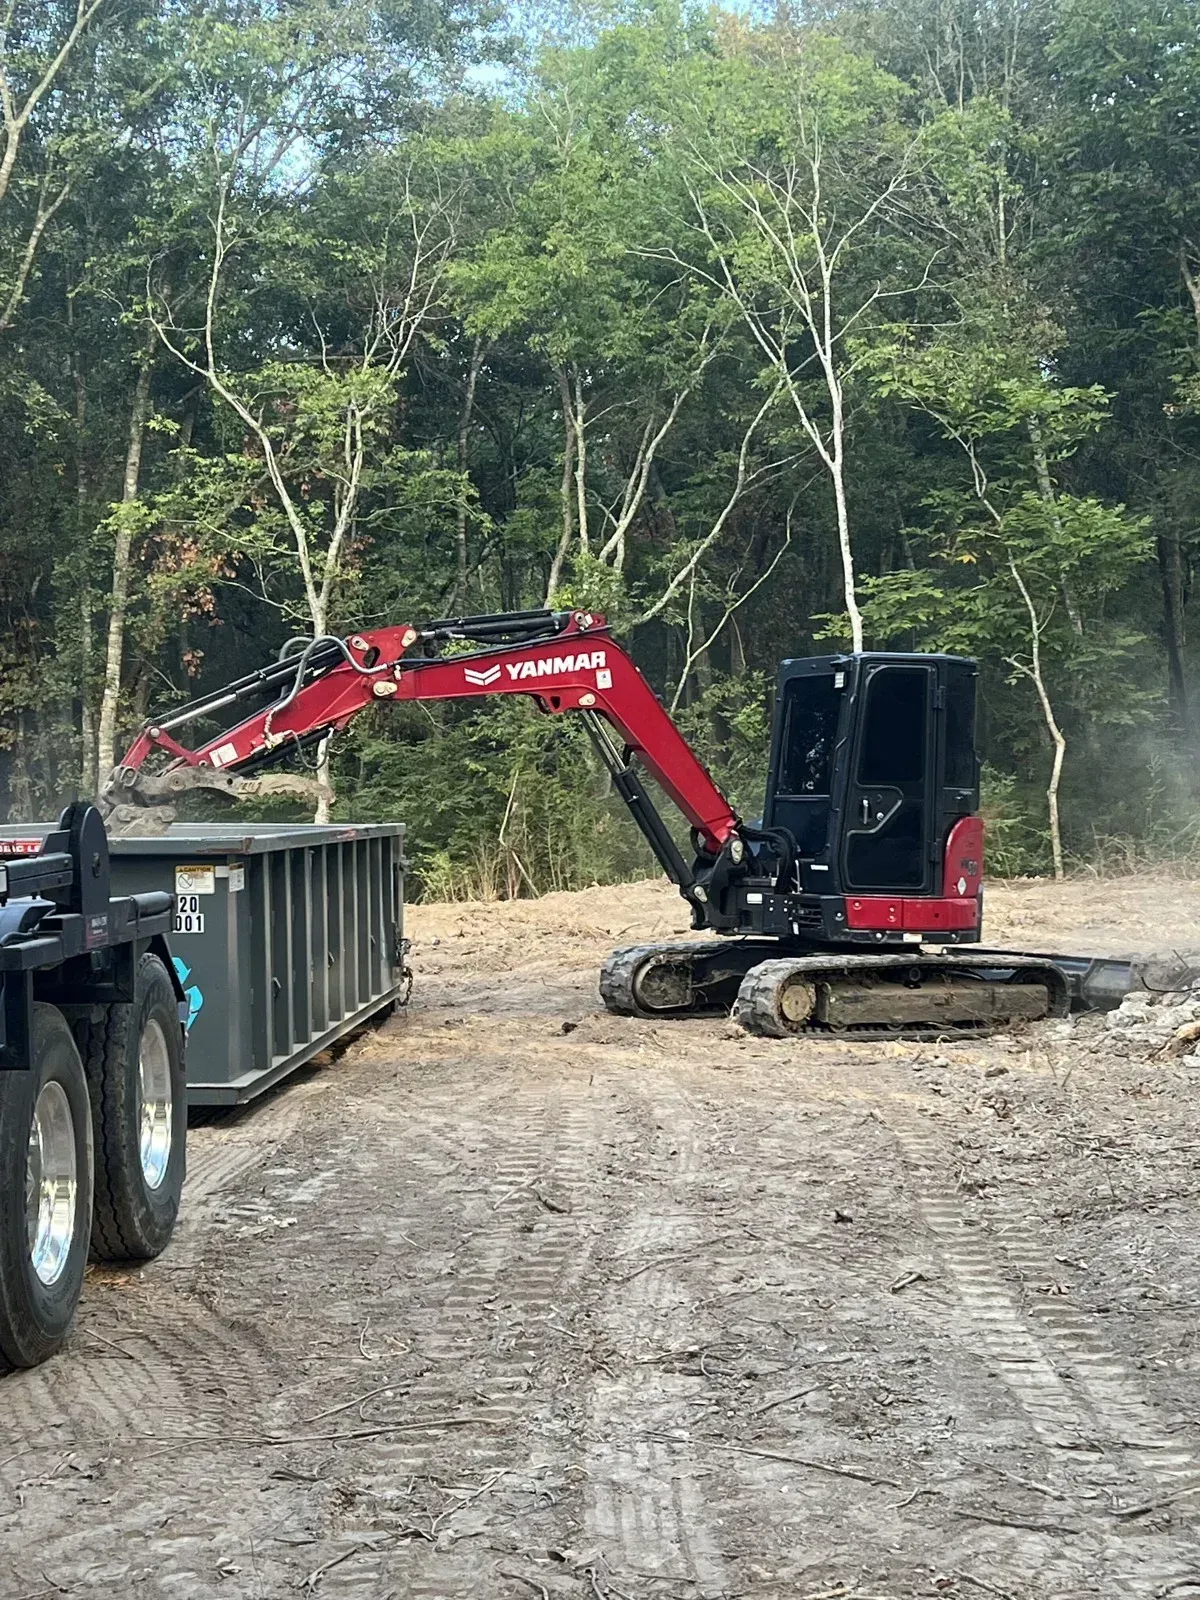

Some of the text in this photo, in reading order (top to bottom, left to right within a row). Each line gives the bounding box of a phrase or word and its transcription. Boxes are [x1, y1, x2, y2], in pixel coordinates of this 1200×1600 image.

[505, 651, 606, 680] YANMAR
[179, 896, 197, 913] 20
[175, 914, 202, 932] 001
